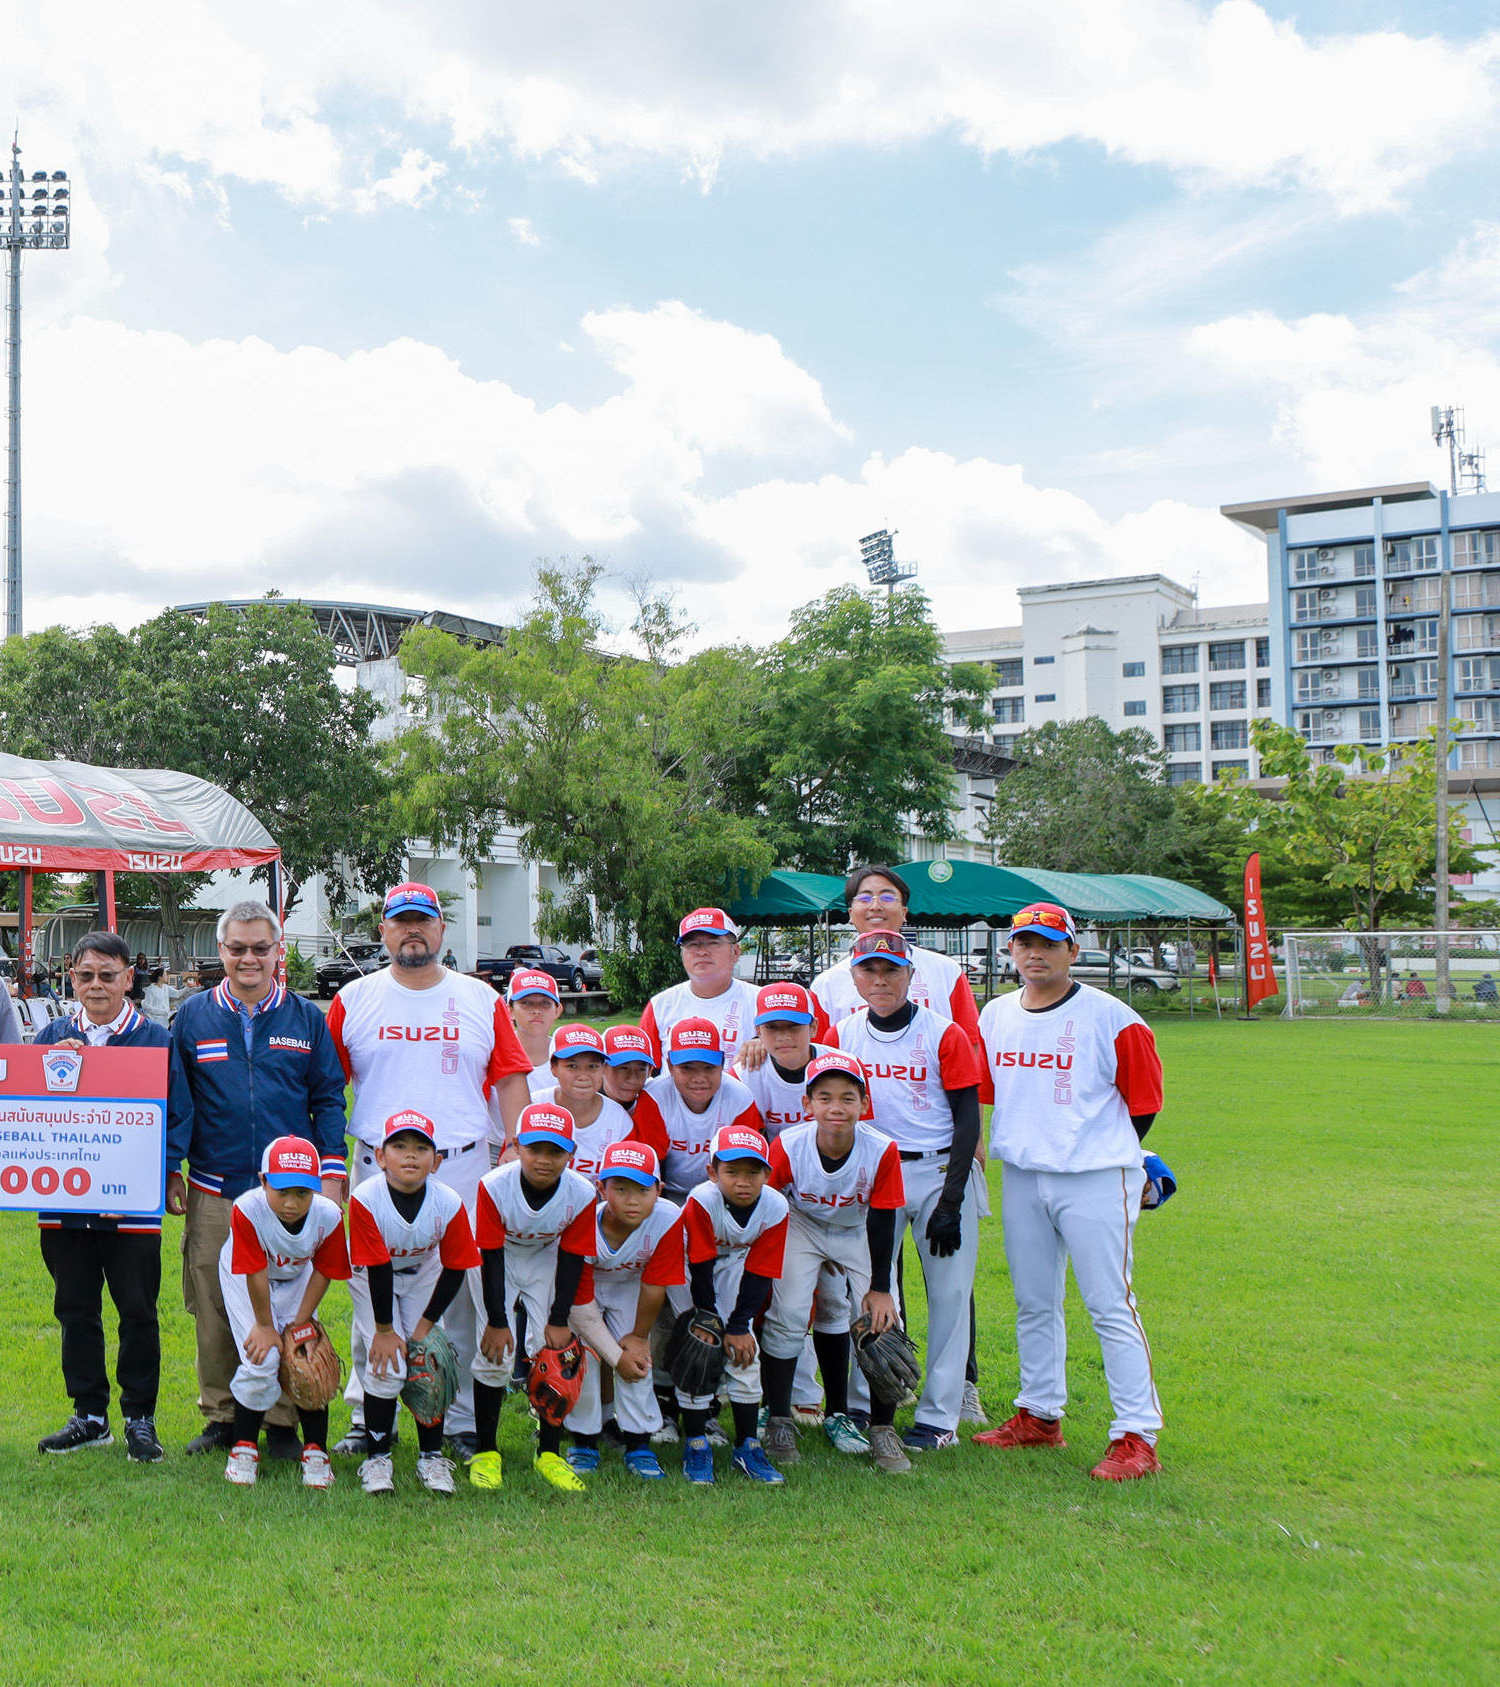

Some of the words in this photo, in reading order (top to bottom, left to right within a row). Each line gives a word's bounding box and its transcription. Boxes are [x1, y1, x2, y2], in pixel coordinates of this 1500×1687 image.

[128, 853, 183, 870] ISUZU
[685, 914, 714, 924] ISUZU
[1248, 877, 1266, 980] ISUZU
[521, 976, 549, 985] ISUZU
[764, 994, 798, 1003] ISUZU
[378, 1026, 460, 1041] ISUZU
[566, 1030, 597, 1042] ISUZU
[678, 1030, 711, 1039] ISUZU
[269, 1036, 311, 1050] BASEBALL
[614, 1035, 645, 1045] ISUZU
[995, 1052, 1073, 1070] ISUZU
[864, 1063, 927, 1081] SUZU
[115, 1111, 154, 1126] 2023
[393, 1113, 427, 1124] ISUZU
[530, 1114, 564, 1124] ISUZU
[52, 1132, 122, 1144] THAILAND
[729, 1133, 762, 1146] ISUZU
[279, 1153, 311, 1162] ISUZU
[611, 1150, 645, 1160] ISUZU
[101, 1183, 127, 1196] บาท
